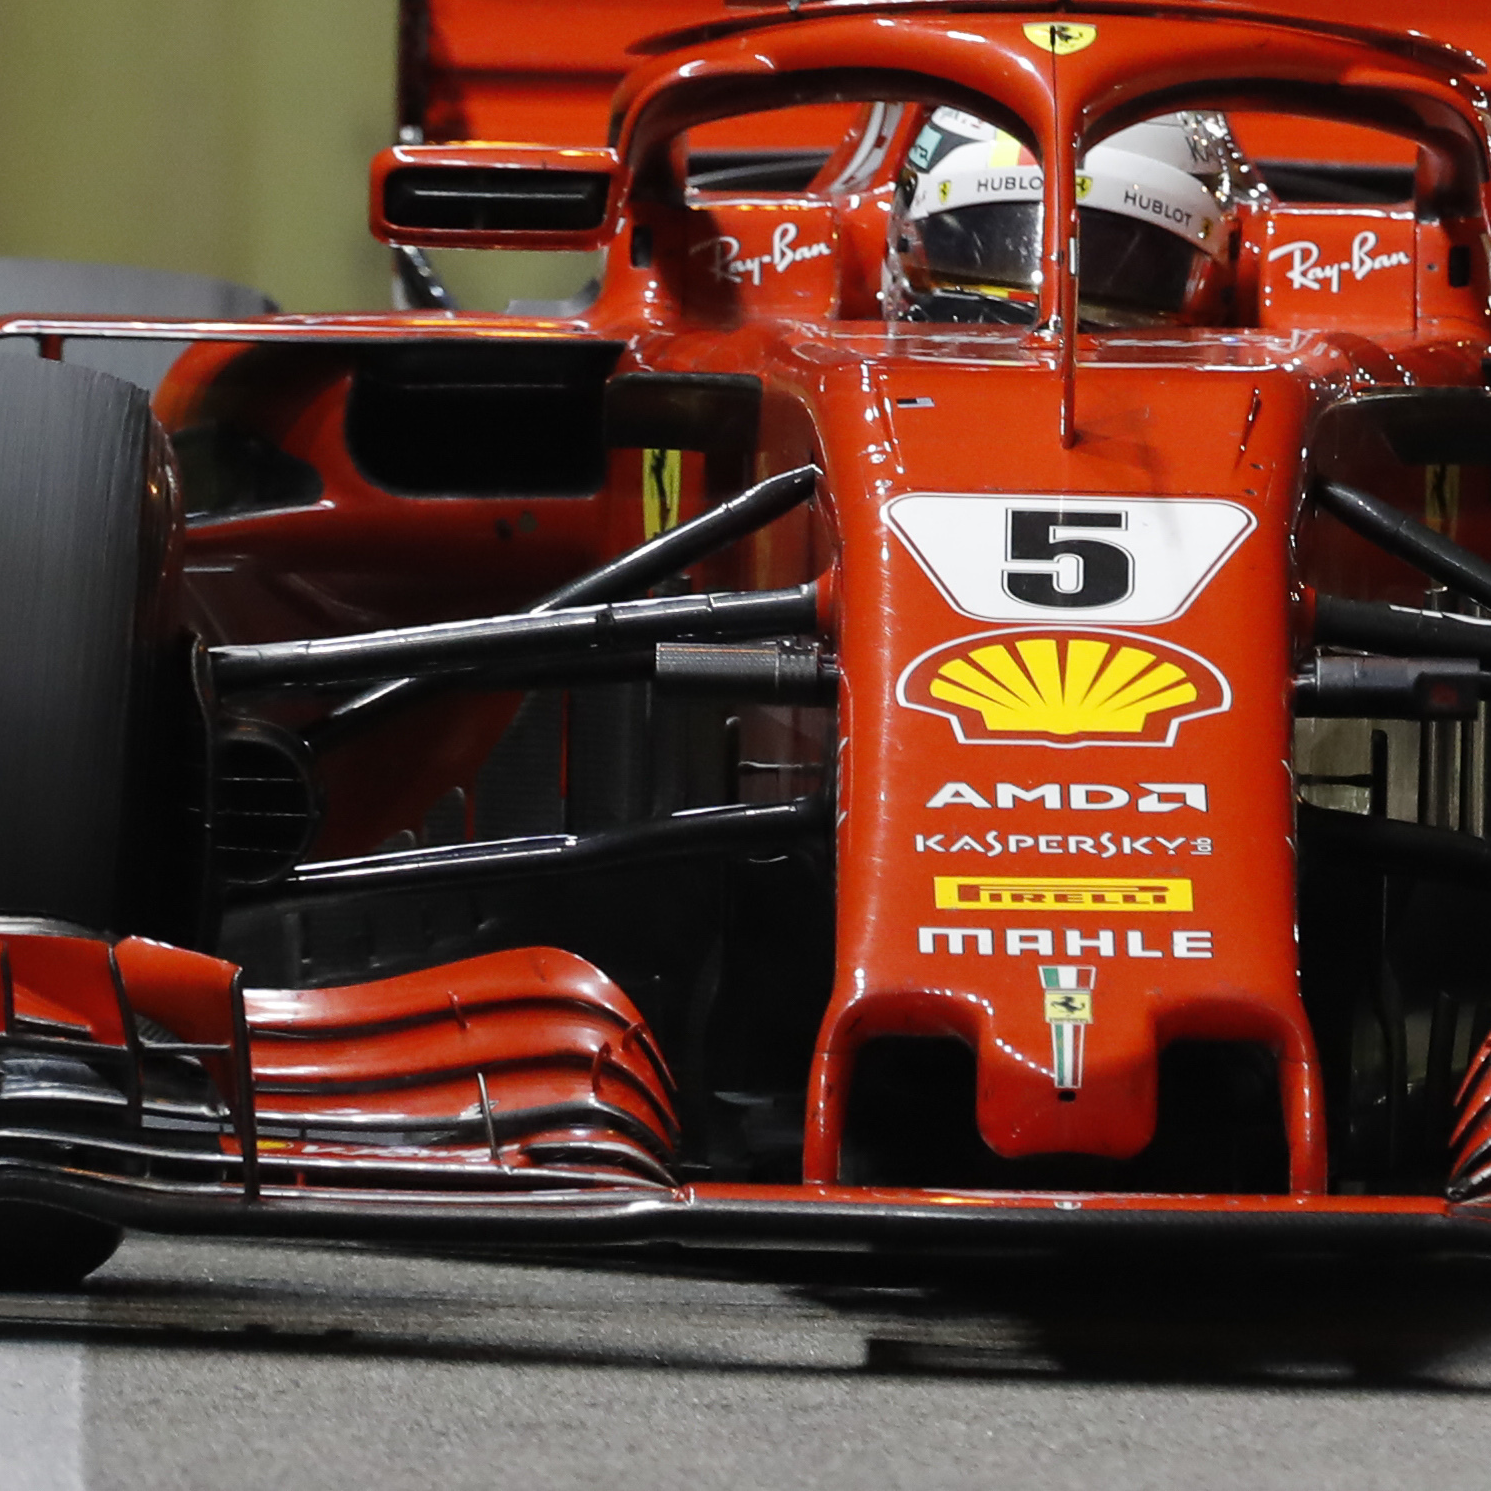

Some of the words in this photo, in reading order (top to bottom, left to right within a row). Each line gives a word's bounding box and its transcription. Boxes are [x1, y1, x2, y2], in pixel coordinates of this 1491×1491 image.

[977, 175, 1044, 193] HUBLO
[1124, 190, 1194, 227] HUBLOT
[689, 222, 833, 286] Ray-Ban
[1267, 230, 1411, 294] Ray-Ban
[1001, 507, 1136, 611] 5
[925, 781, 1132, 811] AMD
[915, 830, 1187, 858] KASPERSKY
[957, 883, 1170, 905] PIRELLI
[917, 926, 1214, 959] MAHLE
